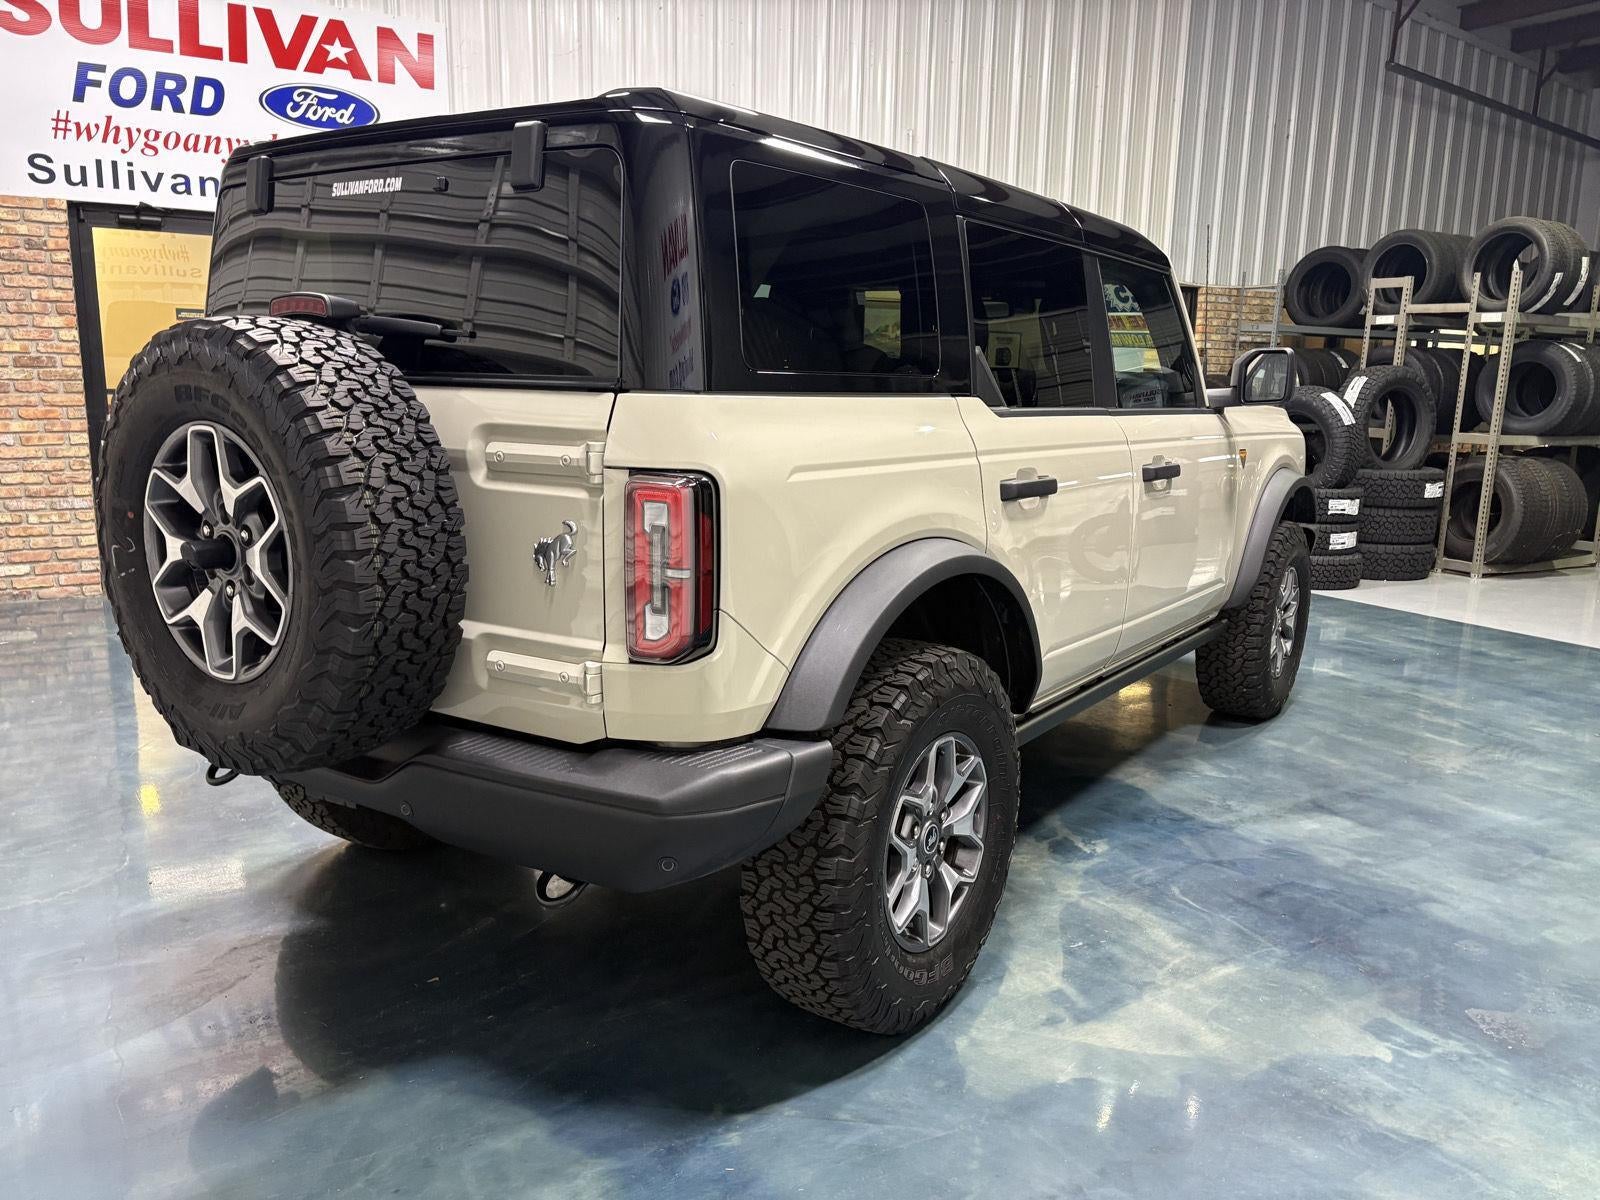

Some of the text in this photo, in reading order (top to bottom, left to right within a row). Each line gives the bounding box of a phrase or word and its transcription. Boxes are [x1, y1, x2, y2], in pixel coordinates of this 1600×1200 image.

[0, 0, 435, 90] SULLIVAN
[72, 61, 225, 116] FORD
[286, 88, 356, 125] Ford
[332, 177, 403, 197] SULLIVANFORD.COM
